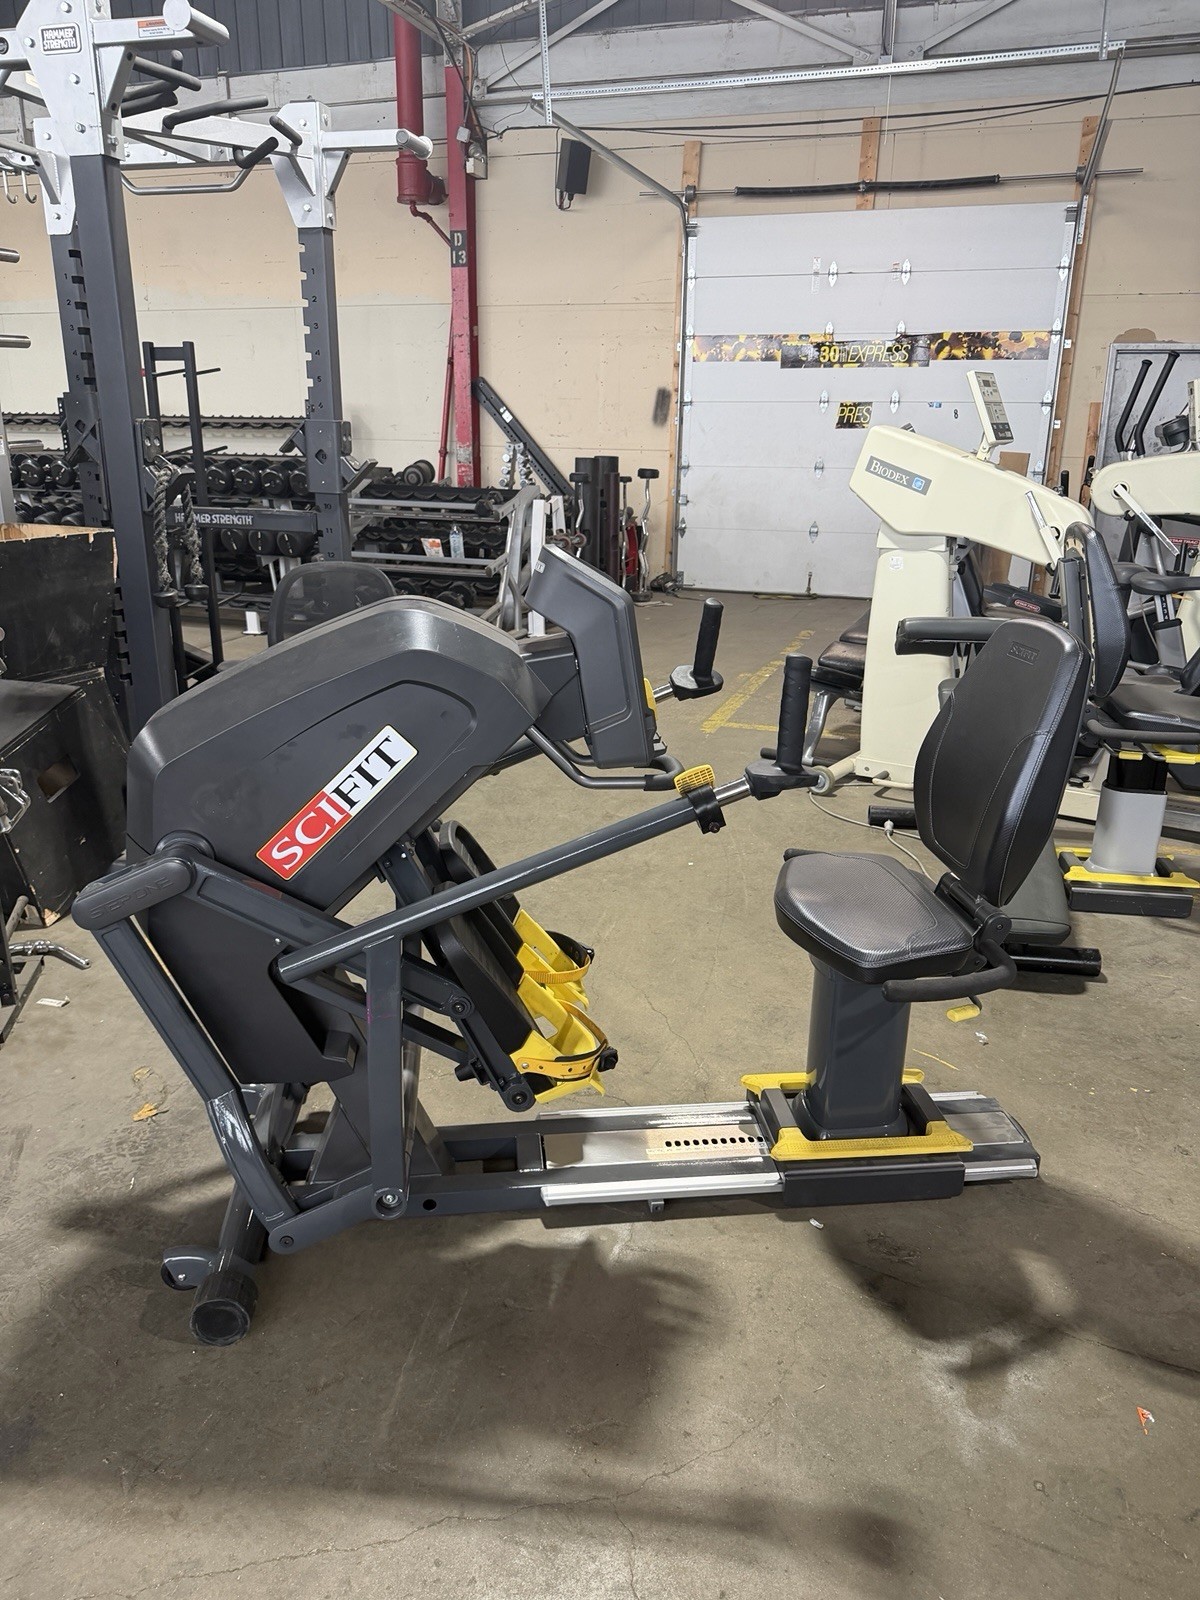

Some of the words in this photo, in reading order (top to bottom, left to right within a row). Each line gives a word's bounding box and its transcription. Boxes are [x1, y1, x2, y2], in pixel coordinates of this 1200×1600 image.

[43, 29, 75, 40] HAMMER
[43, 38, 77, 50] STRENGTH
[454, 232, 462, 246] D
[452, 250, 466, 264] 13
[819, 346, 840, 363] 30
[847, 344, 912, 363] EXPRESS
[869, 459, 910, 485] BIODEX
[212, 514, 254, 525] STRENGTH
[270, 735, 402, 872] SCIFIT
